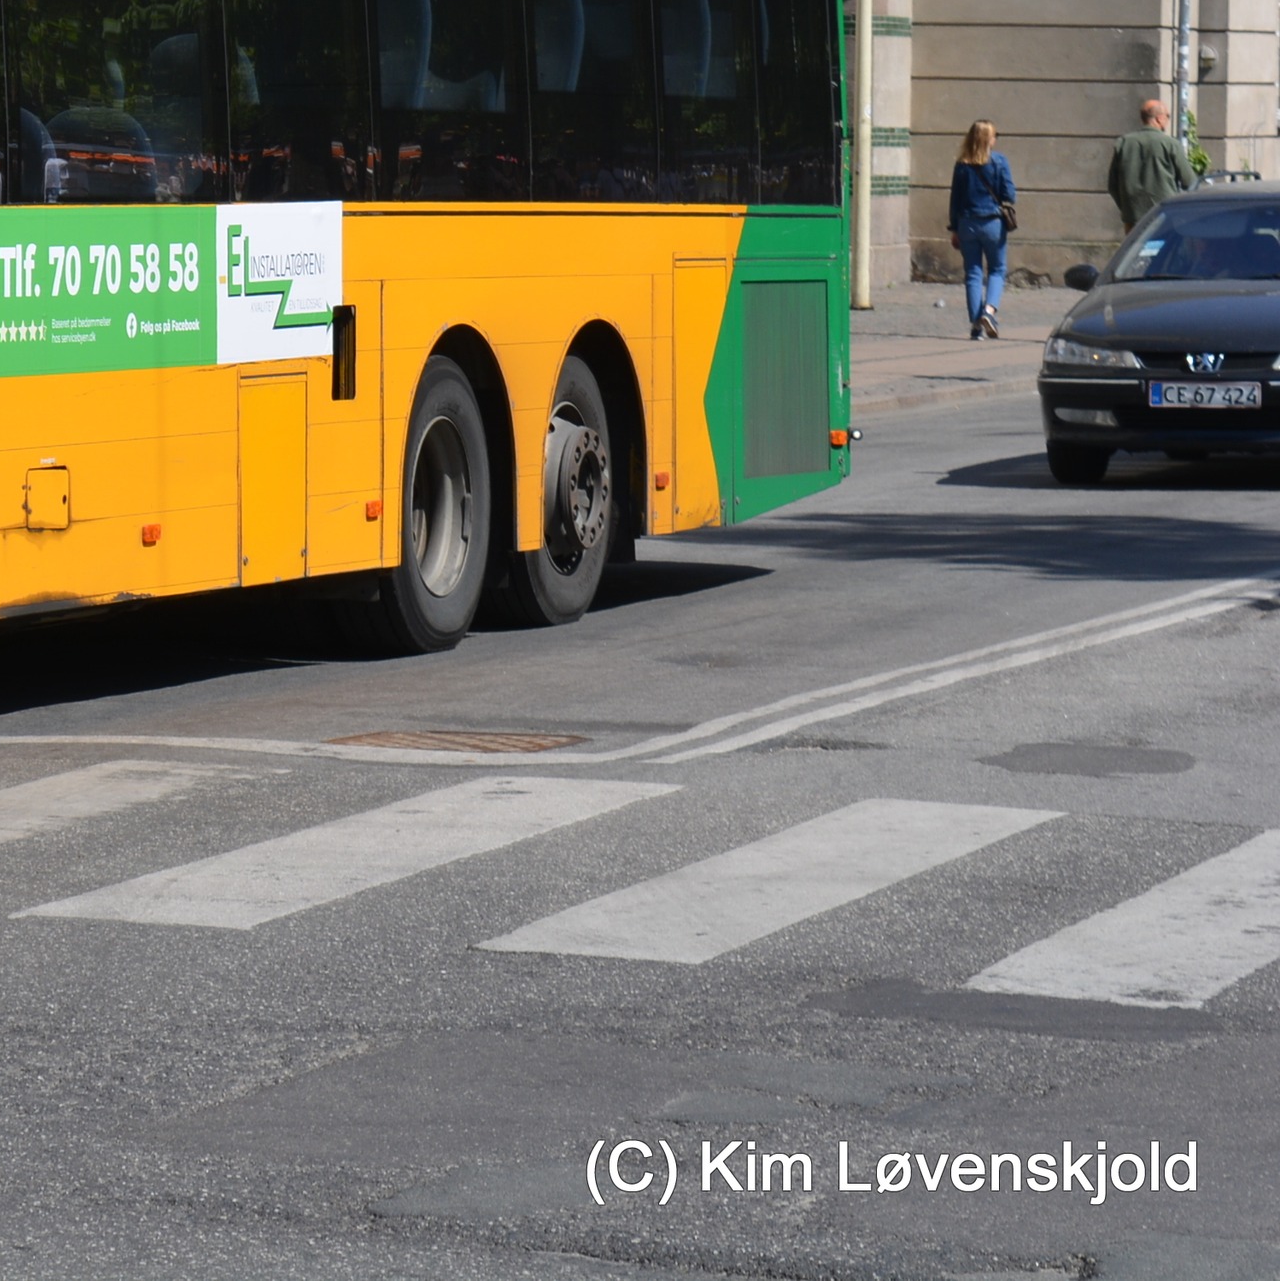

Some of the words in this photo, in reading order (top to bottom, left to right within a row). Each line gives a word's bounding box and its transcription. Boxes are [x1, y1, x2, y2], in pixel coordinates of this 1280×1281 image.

[48, 245, 81, 296] 70
[89, 244, 122, 295] 70
[129, 243, 161, 293] 58
[168, 242, 199, 292] 58
[154, 322, 162, 332] os
[162, 319, 171, 334] på
[171, 319, 200, 332] Facebook
[1163, 386, 1188, 404] CE
[1193, 387, 1216, 404] 67
[1222, 386, 1257, 405] 424
